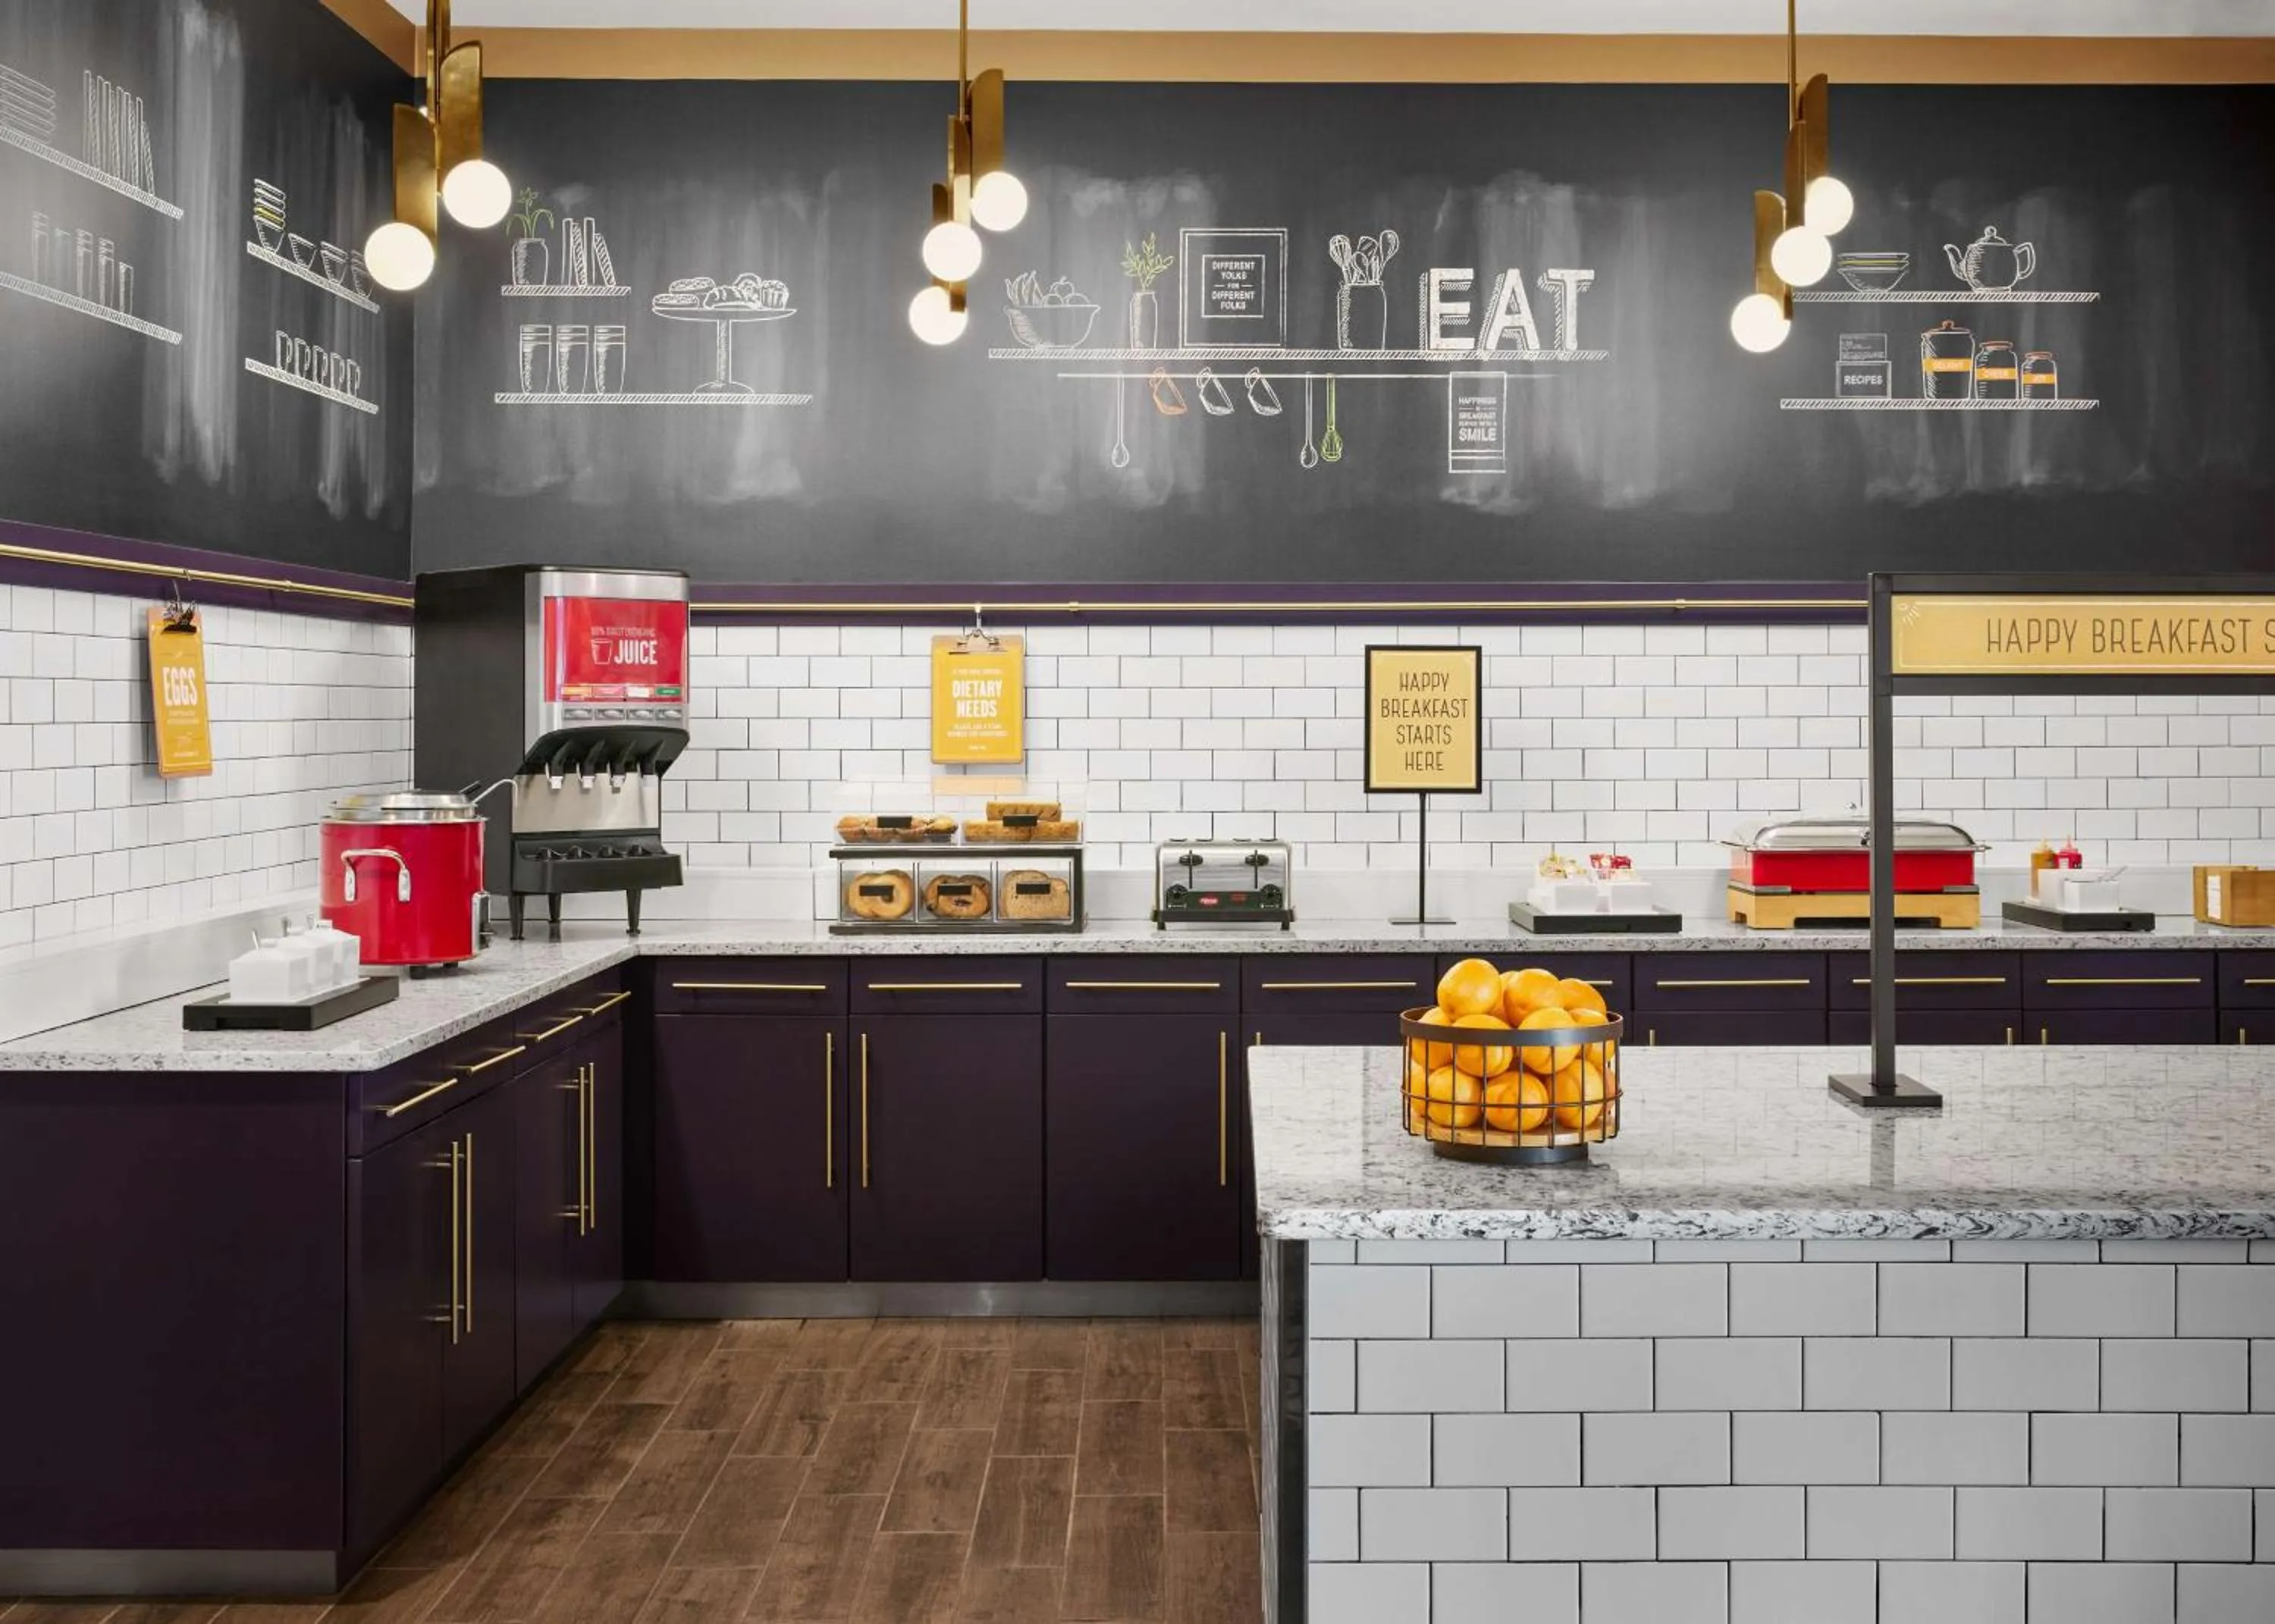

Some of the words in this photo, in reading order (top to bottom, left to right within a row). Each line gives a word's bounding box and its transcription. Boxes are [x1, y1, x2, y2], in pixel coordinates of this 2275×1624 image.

[1213, 261, 1255, 270] DIFFERENT
[1221, 271, 1247, 280] YOLKS
[1212, 291, 1255, 299] DIFFERENT
[1220, 301, 1246, 310] FOLKS
[1420, 268, 1595, 350] EAT
[1844, 375, 1883, 385] RECIPES
[1459, 428, 1496, 441] SMILE
[1986, 618, 2078, 654] HAPPY
[2091, 618, 2251, 654] BREAKFAST
[613, 640, 658, 665] JUICE
[162, 666, 199, 707] EGGS
[952, 679, 1003, 698] DIETARY
[1399, 672, 1449, 692] HAPPY
[956, 700, 998, 718] NEEDS
[1381, 698, 1469, 718] BREAKFAST
[1396, 724, 1452, 745] STARTS
[1405, 751, 1445, 771] HERE
